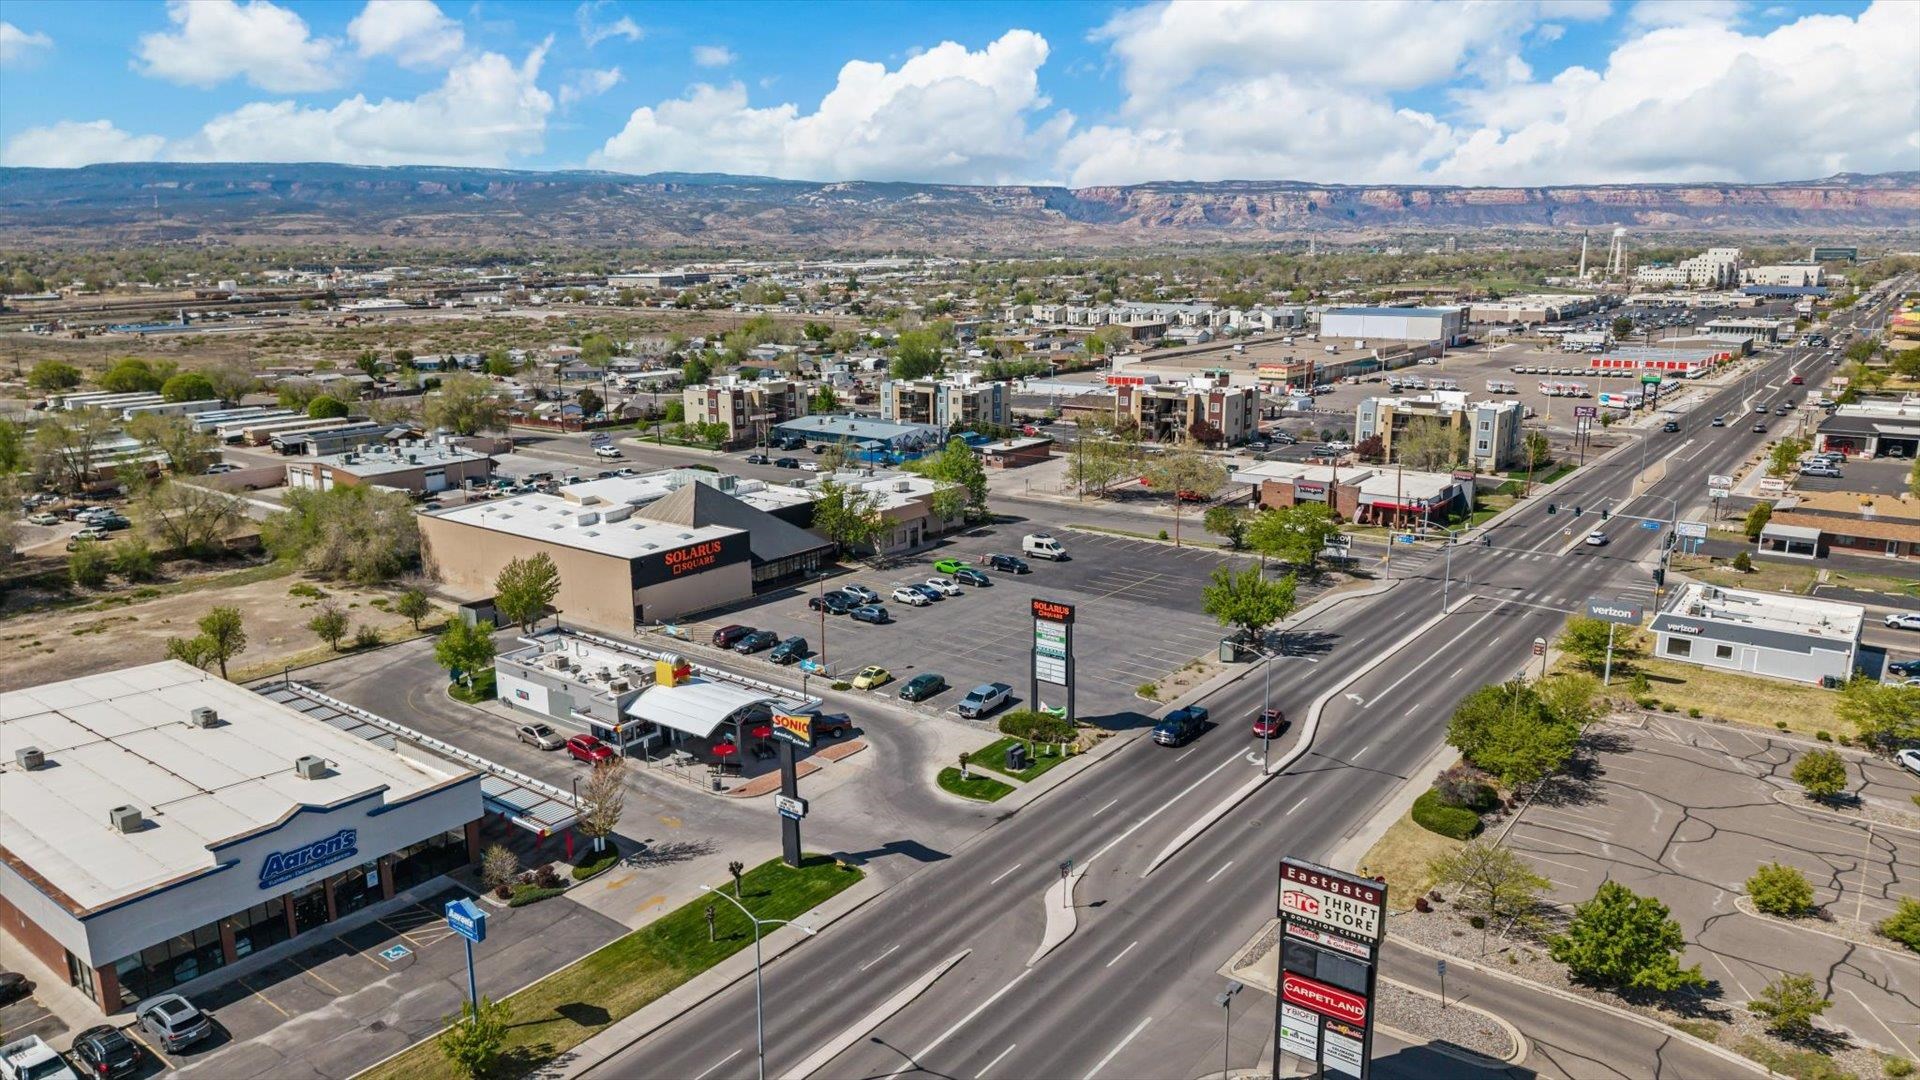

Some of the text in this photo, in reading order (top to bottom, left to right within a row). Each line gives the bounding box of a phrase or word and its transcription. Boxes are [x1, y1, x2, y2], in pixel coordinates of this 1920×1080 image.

[664, 540, 721, 565] SOLARUS
[681, 555, 716, 570] SQUARE
[1033, 601, 1070, 615] SOLARUS
[1592, 605, 1632, 618] verizon
[1667, 622, 1699, 634] verizon
[774, 714, 809, 733] SONIC
[260, 829, 357, 880] Aaron's
[1287, 867, 1374, 901] Eastgate
[1283, 891, 1319, 914] arc
[1323, 895, 1378, 920] THRIFT
[1290, 914, 1336, 931] DONATION
[1339, 929, 1374, 943] CENTER
[1324, 908, 1373, 932] STORE
[1284, 982, 1364, 1015] CARPETLAND
